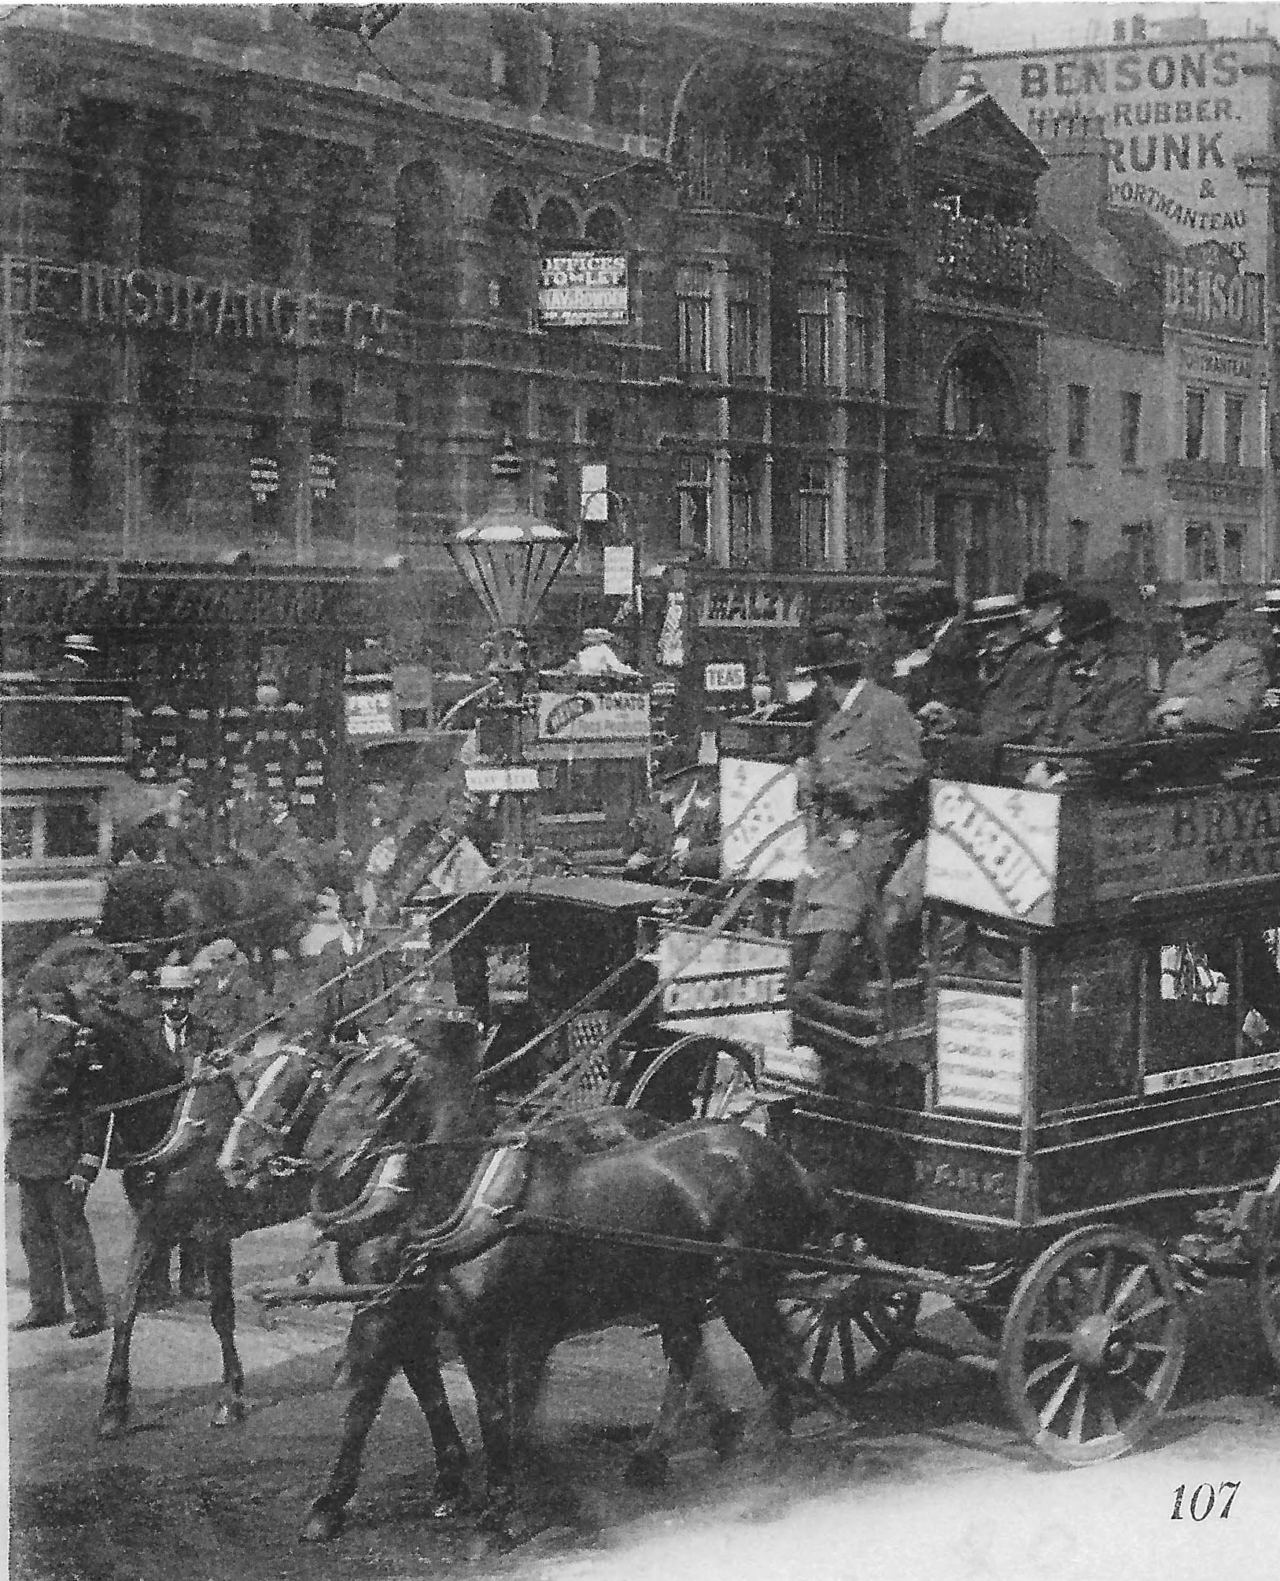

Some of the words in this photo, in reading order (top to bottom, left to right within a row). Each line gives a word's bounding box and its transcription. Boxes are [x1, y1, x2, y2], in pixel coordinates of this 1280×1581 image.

[1103, 131, 1226, 174] RUNK
[1108, 181, 1247, 231] PORTMANTEAU
[1199, 177, 1217, 199] &
[78, 262, 327, 347] INSURANCE
[1164, 264, 1260, 328] BENSON
[708, 669, 743, 689] TEAS
[1162, 1062, 1234, 1090] MANOR
